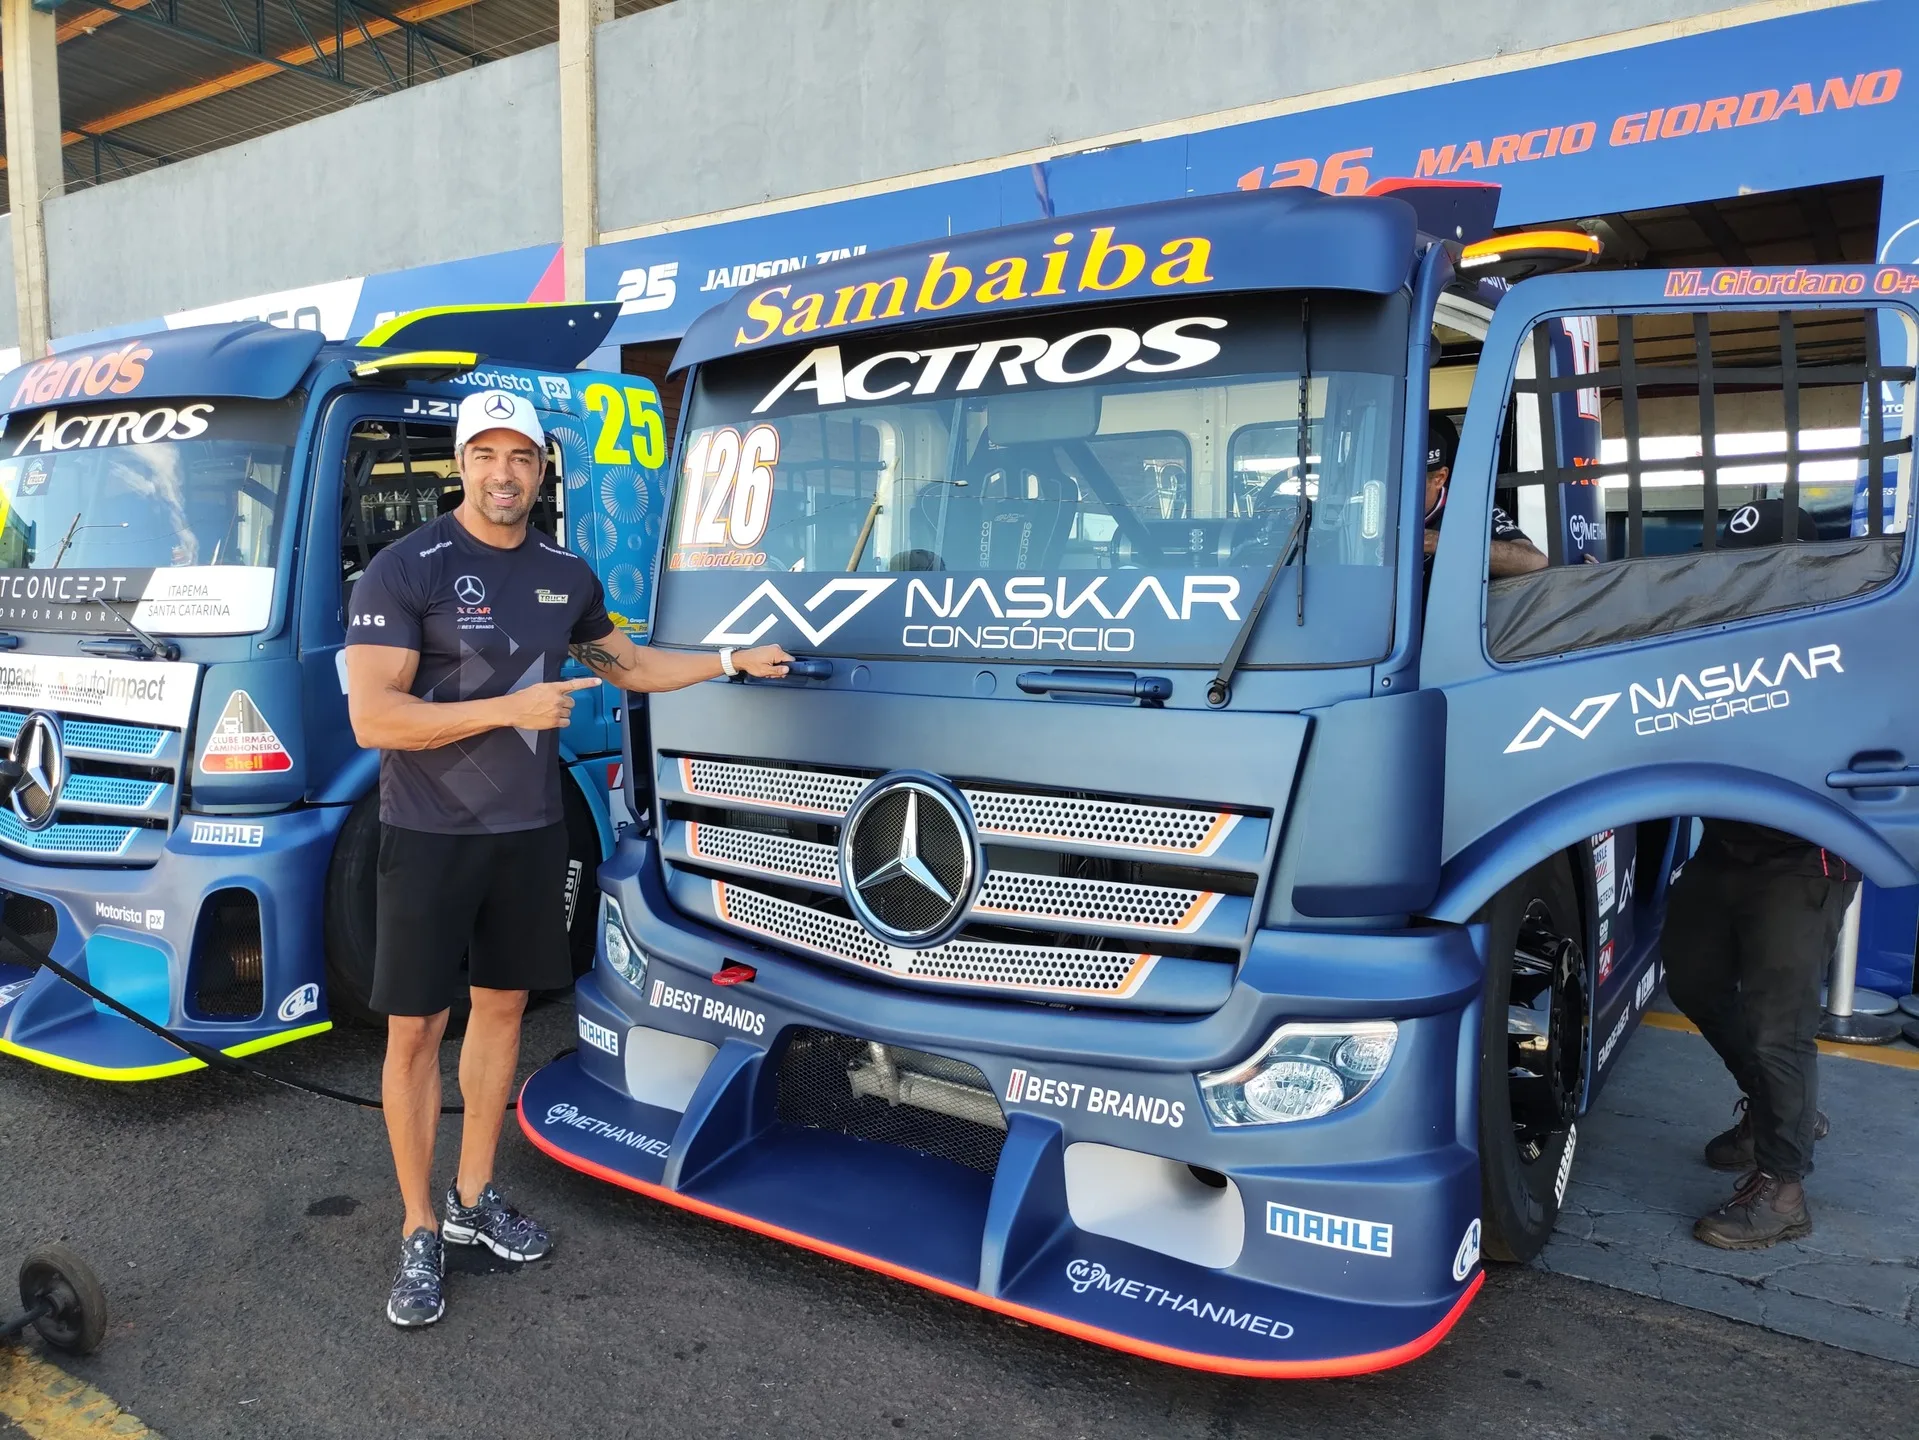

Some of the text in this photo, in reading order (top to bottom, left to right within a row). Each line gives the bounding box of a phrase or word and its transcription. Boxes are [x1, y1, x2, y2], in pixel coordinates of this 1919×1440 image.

[1415, 121, 1597, 178] MARCIO
[1608, 68, 1903, 147] GIORDANO
[615, 261, 679, 316] 25
[700, 256, 808, 291] JAIDSON
[734, 226, 1215, 348] Sambaiba
[448, 371, 533, 392] otorista
[404, 399, 459, 417] J.ZI
[584, 383, 665, 469] 25
[1428, 449, 1441, 459] SG
[678, 424, 781, 549] 126
[689, 551, 767, 567] Giordano
[168, 585, 209, 597] ITAPEMA
[904, 576, 1242, 621] NASKAR
[148, 605, 231, 617] SANTA CATARINA
[352, 614, 386, 627] ASG
[901, 620, 1135, 652] CONSÓRCIO
[76, 669, 166, 706] autoimpact
[1629, 644, 1844, 714] NASKAR
[1634, 689, 1790, 737] CONSÓRCIO
[209, 743, 280, 752] CAMINHONEIRO
[212, 733, 275, 744] CLUBE IRMÃO
[225, 755, 263, 769] Shell
[193, 824, 262, 844] MAHLE
[96, 901, 142, 924] Motorista
[662, 986, 766, 1036] BEST BRANDS
[579, 1018, 617, 1053] MAHLE
[1025, 1076, 1186, 1129] BEST BRANDS
[1270, 1206, 1390, 1252] MAHLE
[1097, 1273, 1294, 1340] METHANMED
